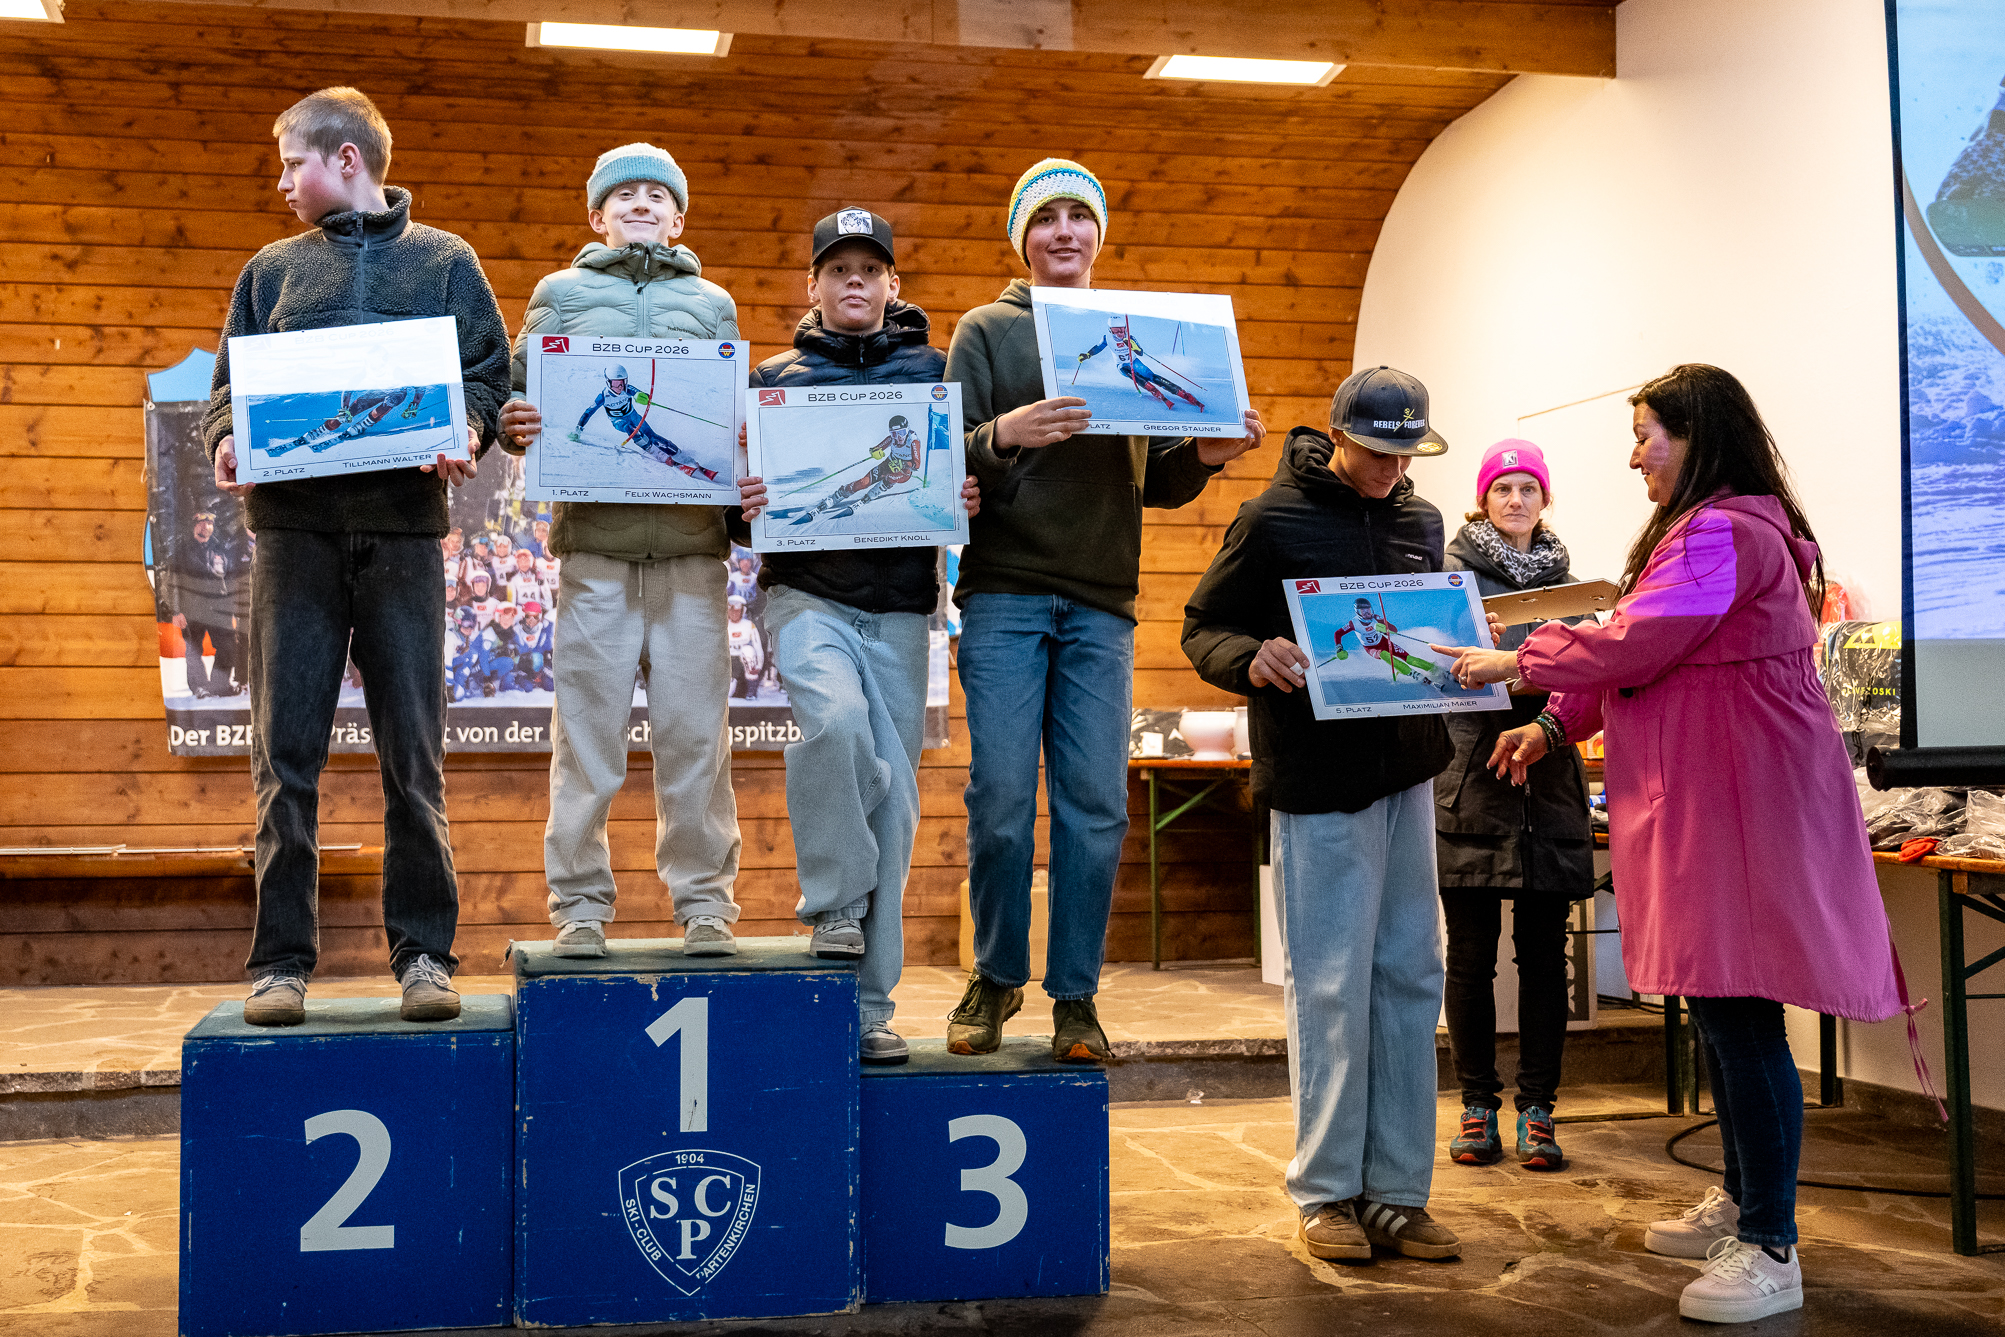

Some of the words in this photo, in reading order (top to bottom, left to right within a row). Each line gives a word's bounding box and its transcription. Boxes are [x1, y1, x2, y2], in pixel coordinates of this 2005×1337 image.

[592, 343, 622, 352] BZB
[655, 346, 689, 354] 2026
[808, 392, 836, 402] BZB
[869, 391, 902, 400] 2026
[1144, 424, 1180, 432] GREGOR
[1373, 420, 1400, 430] REBELS
[274, 467, 305, 476] PLATZ
[343, 458, 390, 468] TILLMANN
[392, 454, 432, 462] WALTER
[624, 490, 650, 498] FELIX
[788, 538, 816, 546] PLATZ
[854, 536, 899, 544] BENEDIKT
[1340, 582, 1366, 590] BZB
[1394, 579, 1424, 588] 2026
[1403, 702, 1450, 710] MAXIMILIAN
[170, 724, 210, 746] Der
[456, 726, 498, 744] von
[504, 720, 544, 744] der
[645, 997, 708, 1132] 1
[676, 1154, 704, 1164] 1904
[300, 1109, 395, 1252] 2
[944, 1114, 1030, 1249] 3
